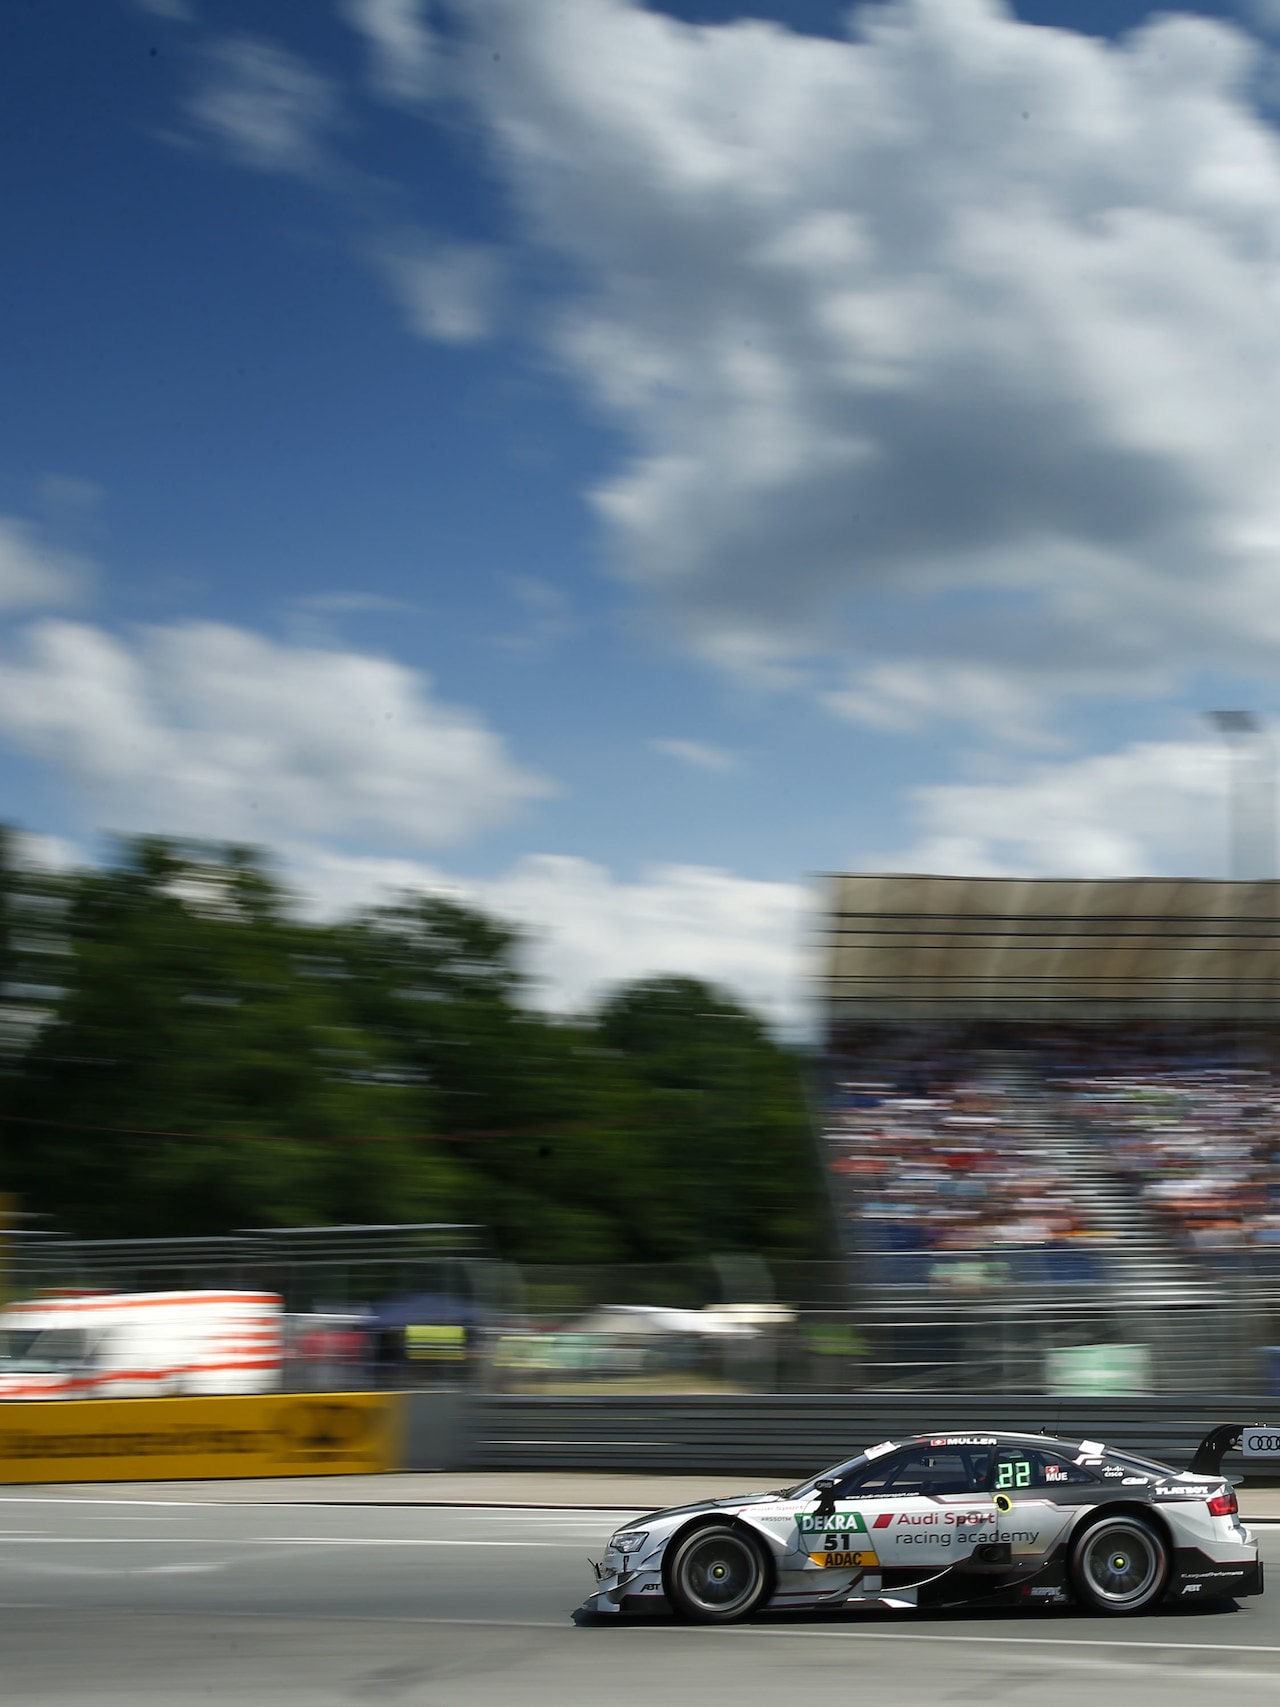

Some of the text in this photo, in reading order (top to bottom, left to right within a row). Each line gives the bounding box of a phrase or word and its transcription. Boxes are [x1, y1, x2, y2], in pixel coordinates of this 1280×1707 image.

[998, 1461, 1031, 1488] 22
[1046, 1472, 1068, 1482] MUE
[1155, 1486, 1209, 1496] PLAYBOY
[802, 1514, 859, 1531] DEKRA
[897, 1512, 996, 1528] Audi Sport
[824, 1534, 850, 1551] 51
[895, 1529, 1040, 1547] racing academy
[825, 1552, 862, 1567] ADAC
[640, 1583, 661, 1593] ABT
[1181, 1583, 1202, 1594] ABT
